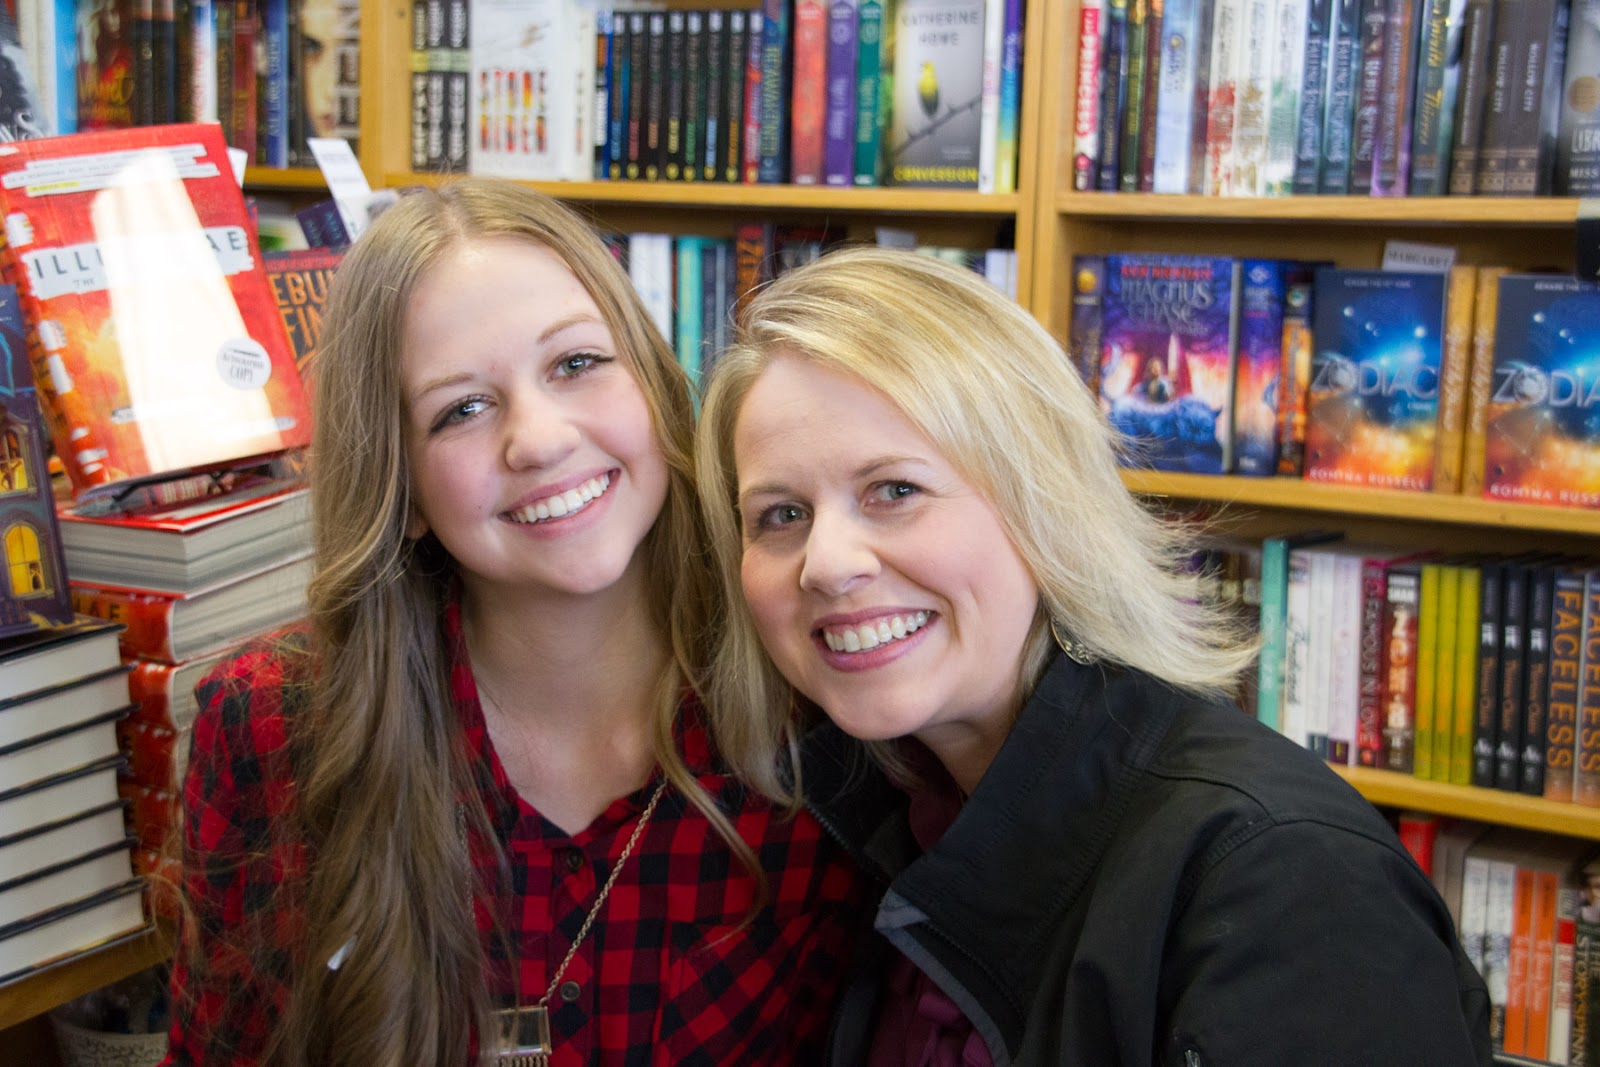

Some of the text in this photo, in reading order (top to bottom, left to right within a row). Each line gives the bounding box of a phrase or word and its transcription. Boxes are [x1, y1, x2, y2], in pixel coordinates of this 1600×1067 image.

[894, 167, 979, 182] CONVERSION
[1311, 358, 1439, 399] ZODIAC
[1310, 467, 1427, 490] ROMINA RUSSELL
[1490, 484, 1600, 505] ROMINA RUSS
[1547, 590, 1582, 768] FACELESS
[1572, 936, 1590, 1066] STORYSPINN
